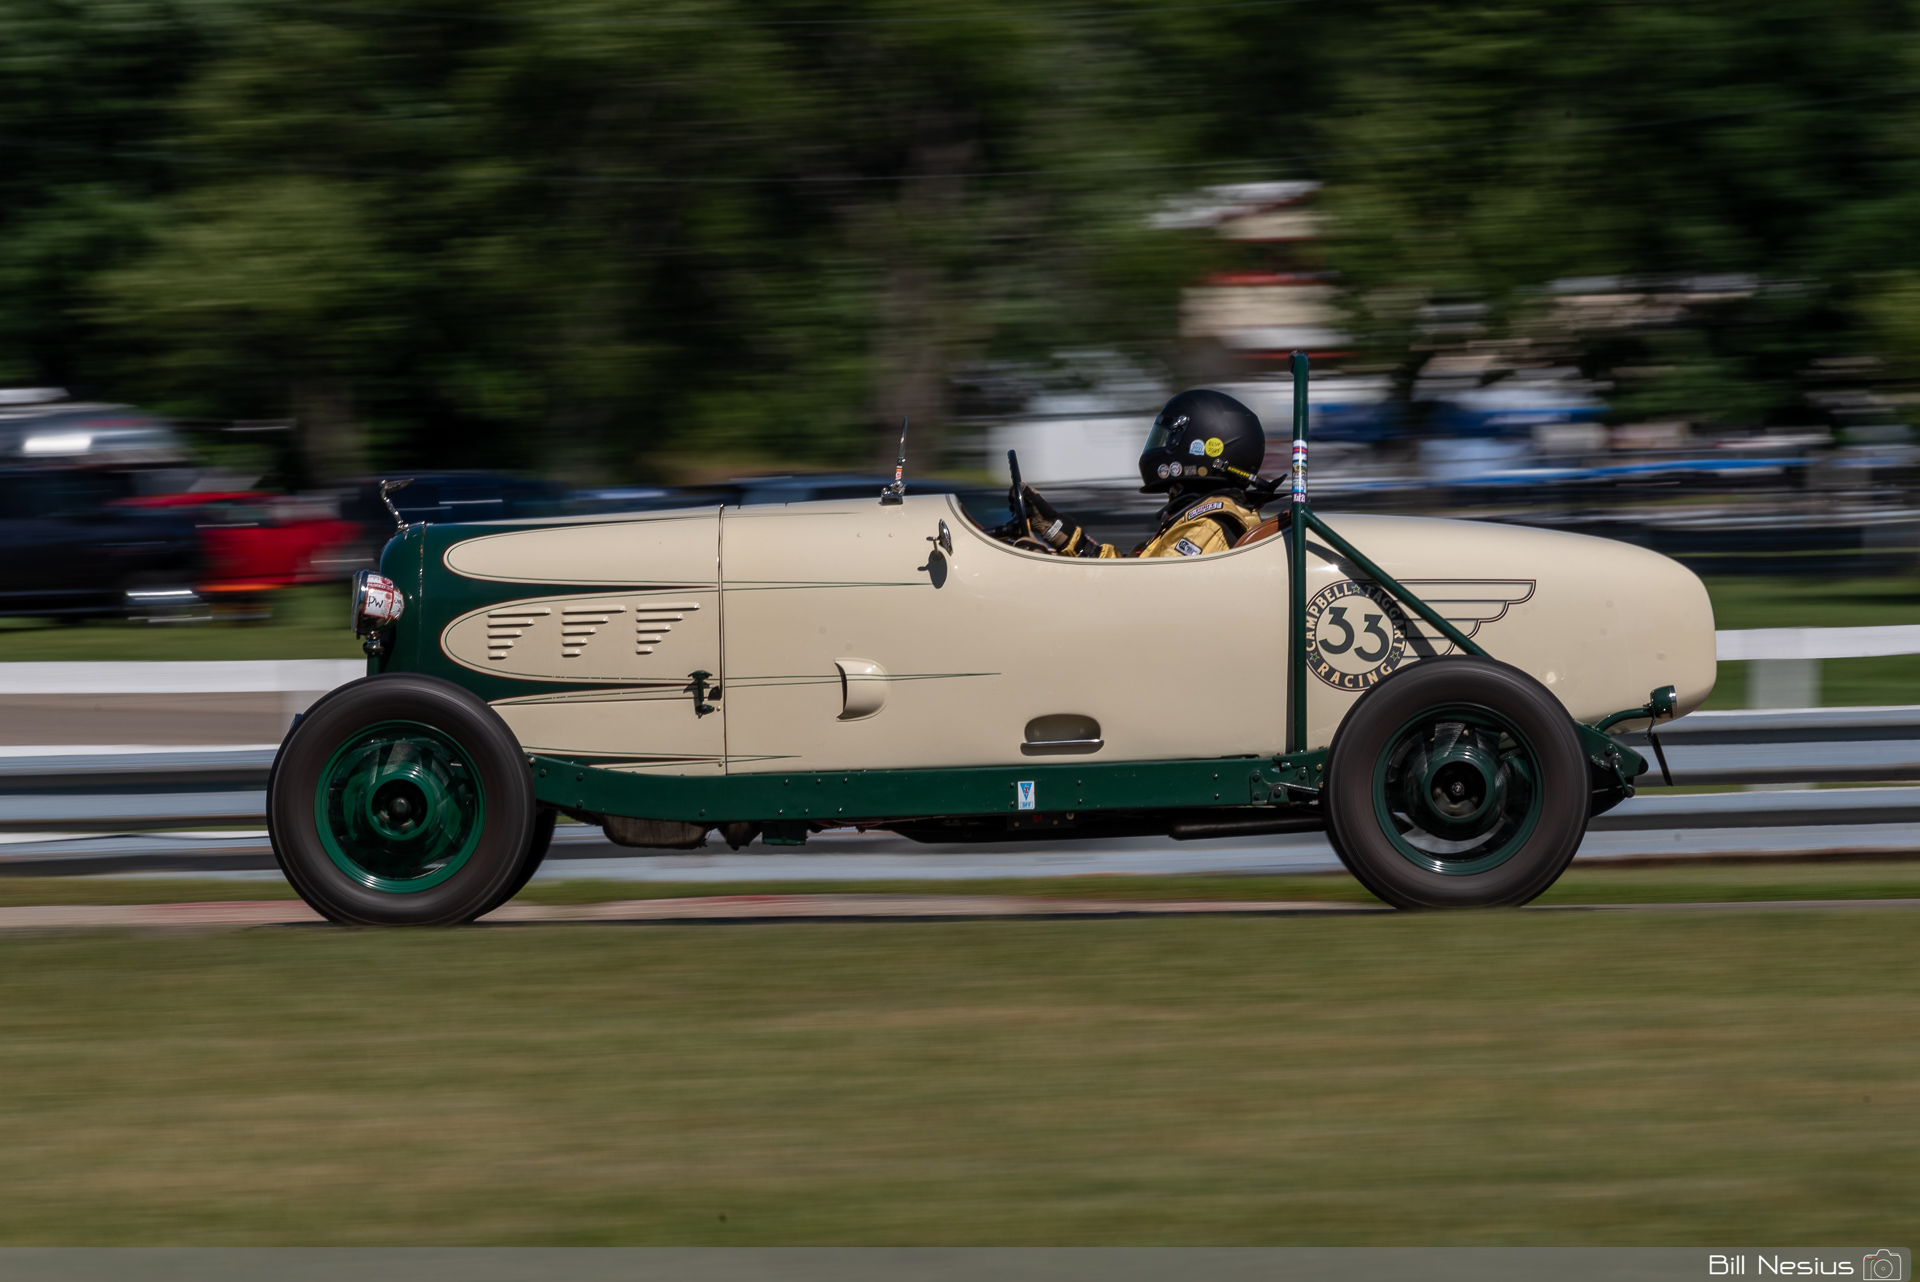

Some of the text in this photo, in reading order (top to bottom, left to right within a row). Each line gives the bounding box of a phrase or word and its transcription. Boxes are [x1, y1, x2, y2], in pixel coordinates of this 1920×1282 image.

[1306, 582, 1406, 652] CAMPBELL TAGGART
[1318, 606, 1390, 662] 33
[1316, 662, 1393, 688] RACING
